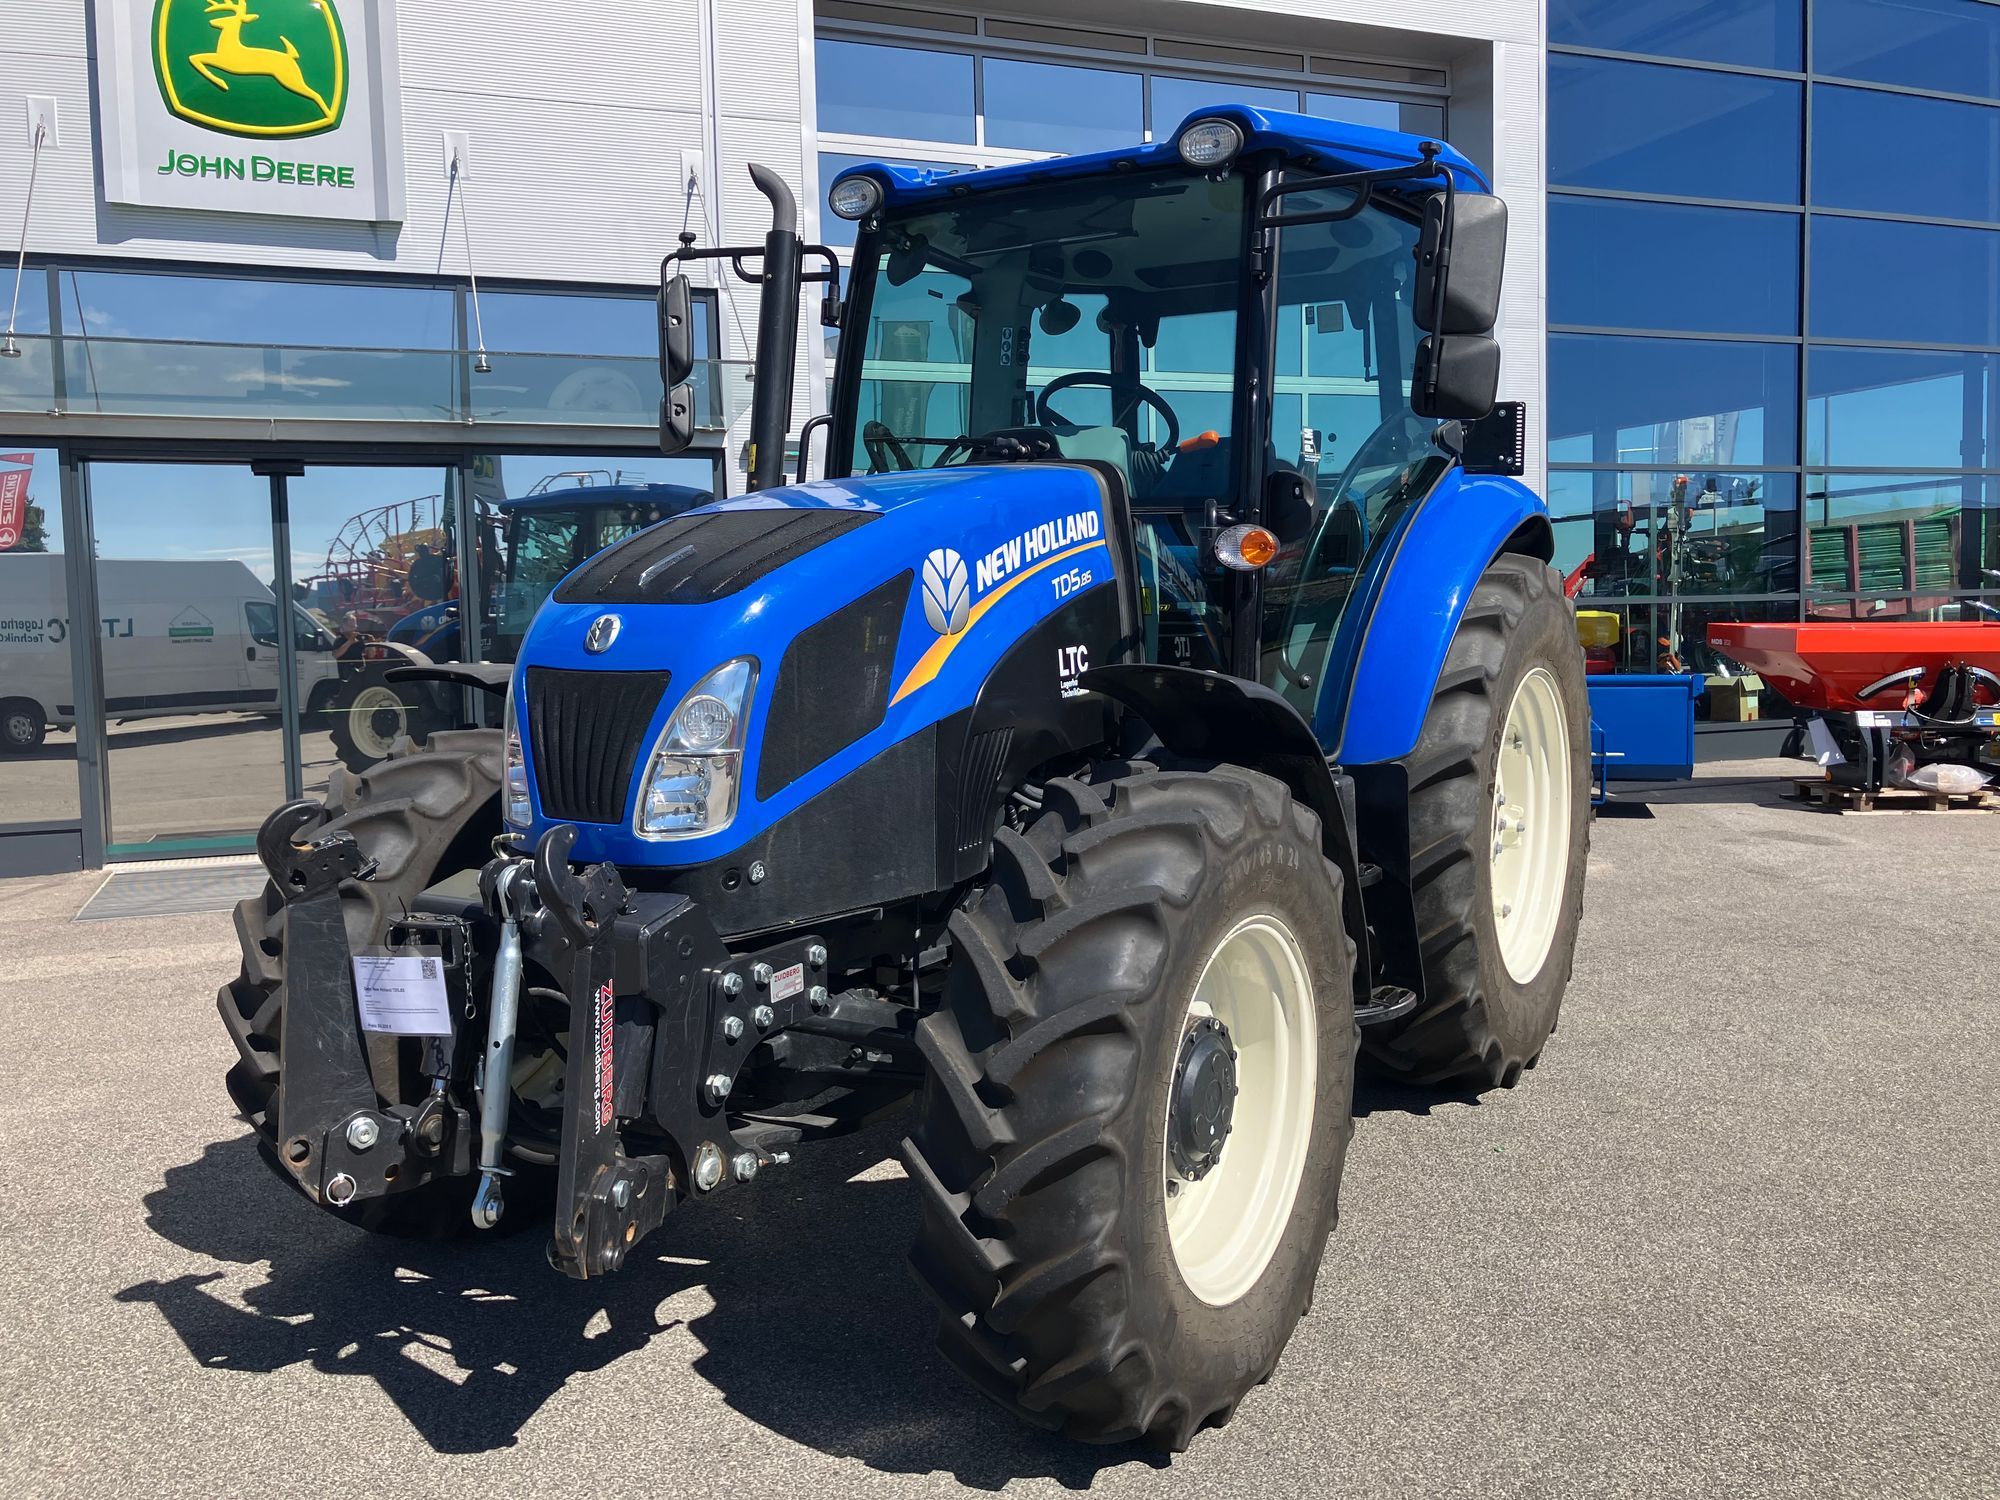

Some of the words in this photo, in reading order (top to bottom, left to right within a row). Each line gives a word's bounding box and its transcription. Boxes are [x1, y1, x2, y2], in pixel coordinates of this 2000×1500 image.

[158, 149, 245, 180] JOHN
[251, 155, 355, 188] DEERE
[3, 473, 19, 525] SILOKING
[976, 536, 1021, 593] NEW
[1024, 510, 1099, 562] HOLLAND
[1052, 567, 1092, 600] TD5.85
[1058, 644, 1089, 677] LTC
[593, 988, 602, 1135] www.zuidberg.com
[601, 978, 614, 1127] ZUIDBERG
